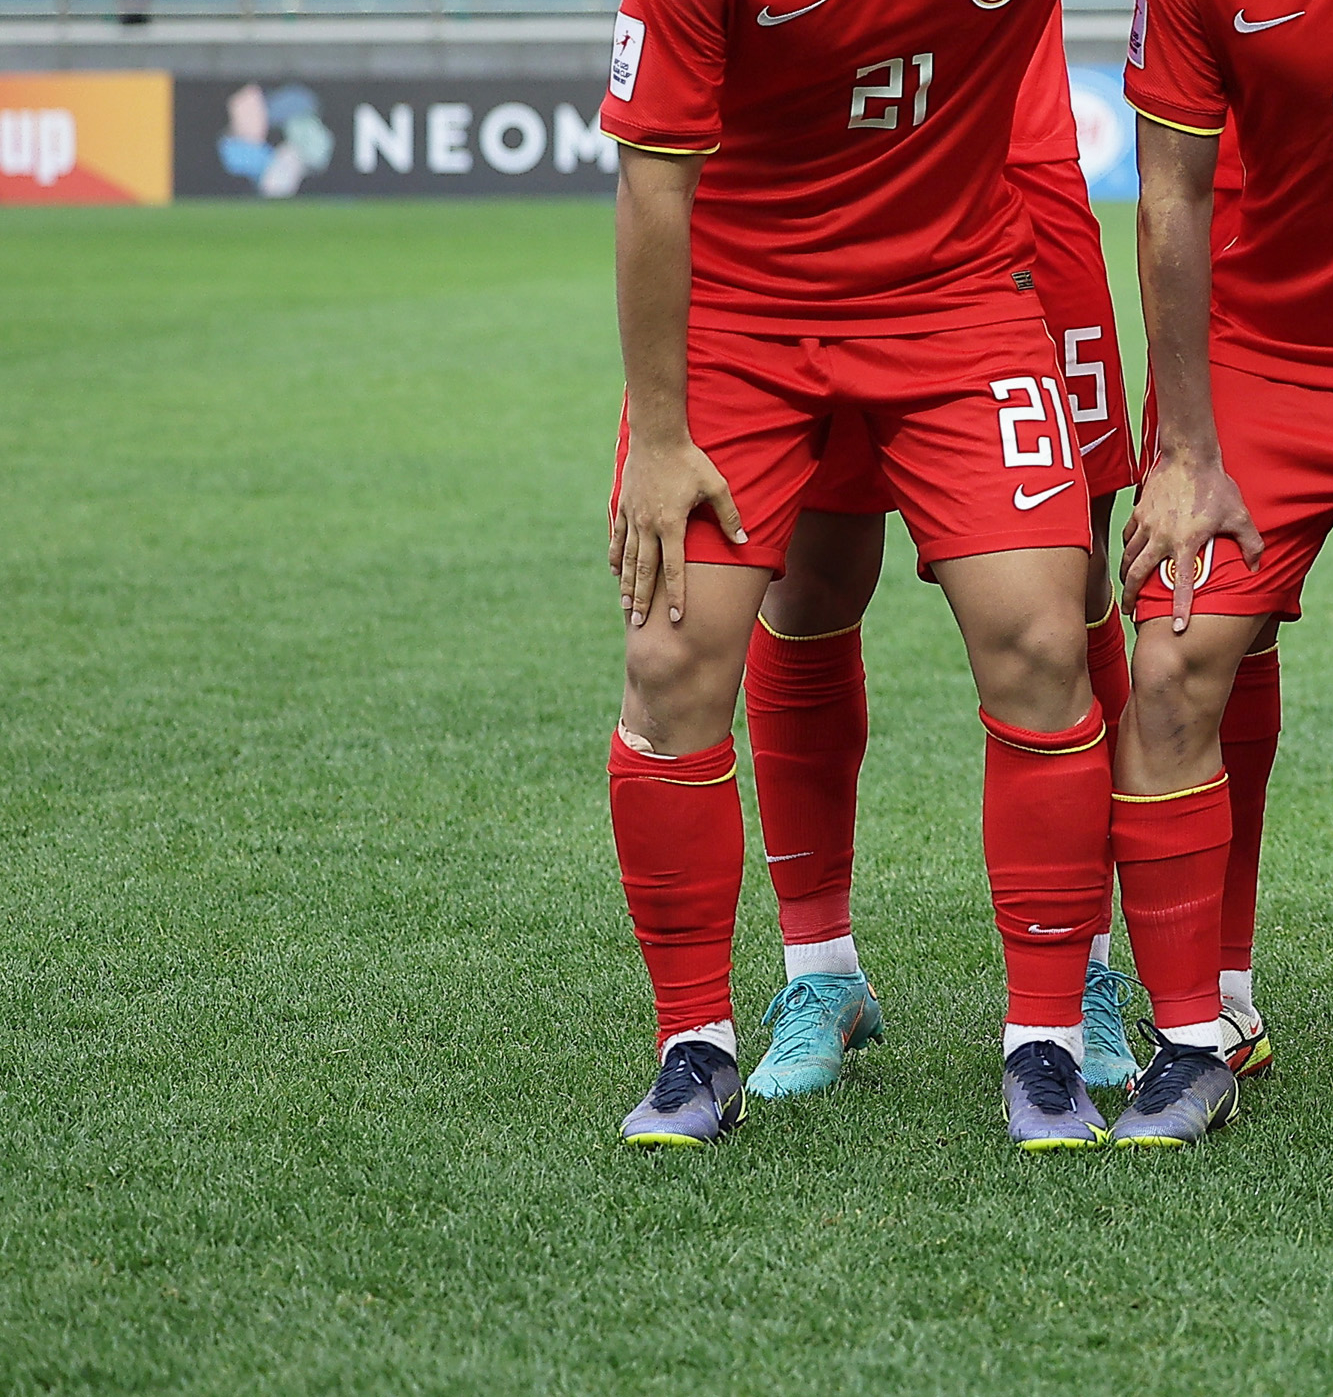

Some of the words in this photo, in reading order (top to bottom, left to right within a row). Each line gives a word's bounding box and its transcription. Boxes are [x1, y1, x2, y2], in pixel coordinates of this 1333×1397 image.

[847, 52, 935, 130] 21
[353, 103, 618, 174] NEOM
[1064, 325, 1109, 423] 5
[989, 375, 1074, 470] 21
